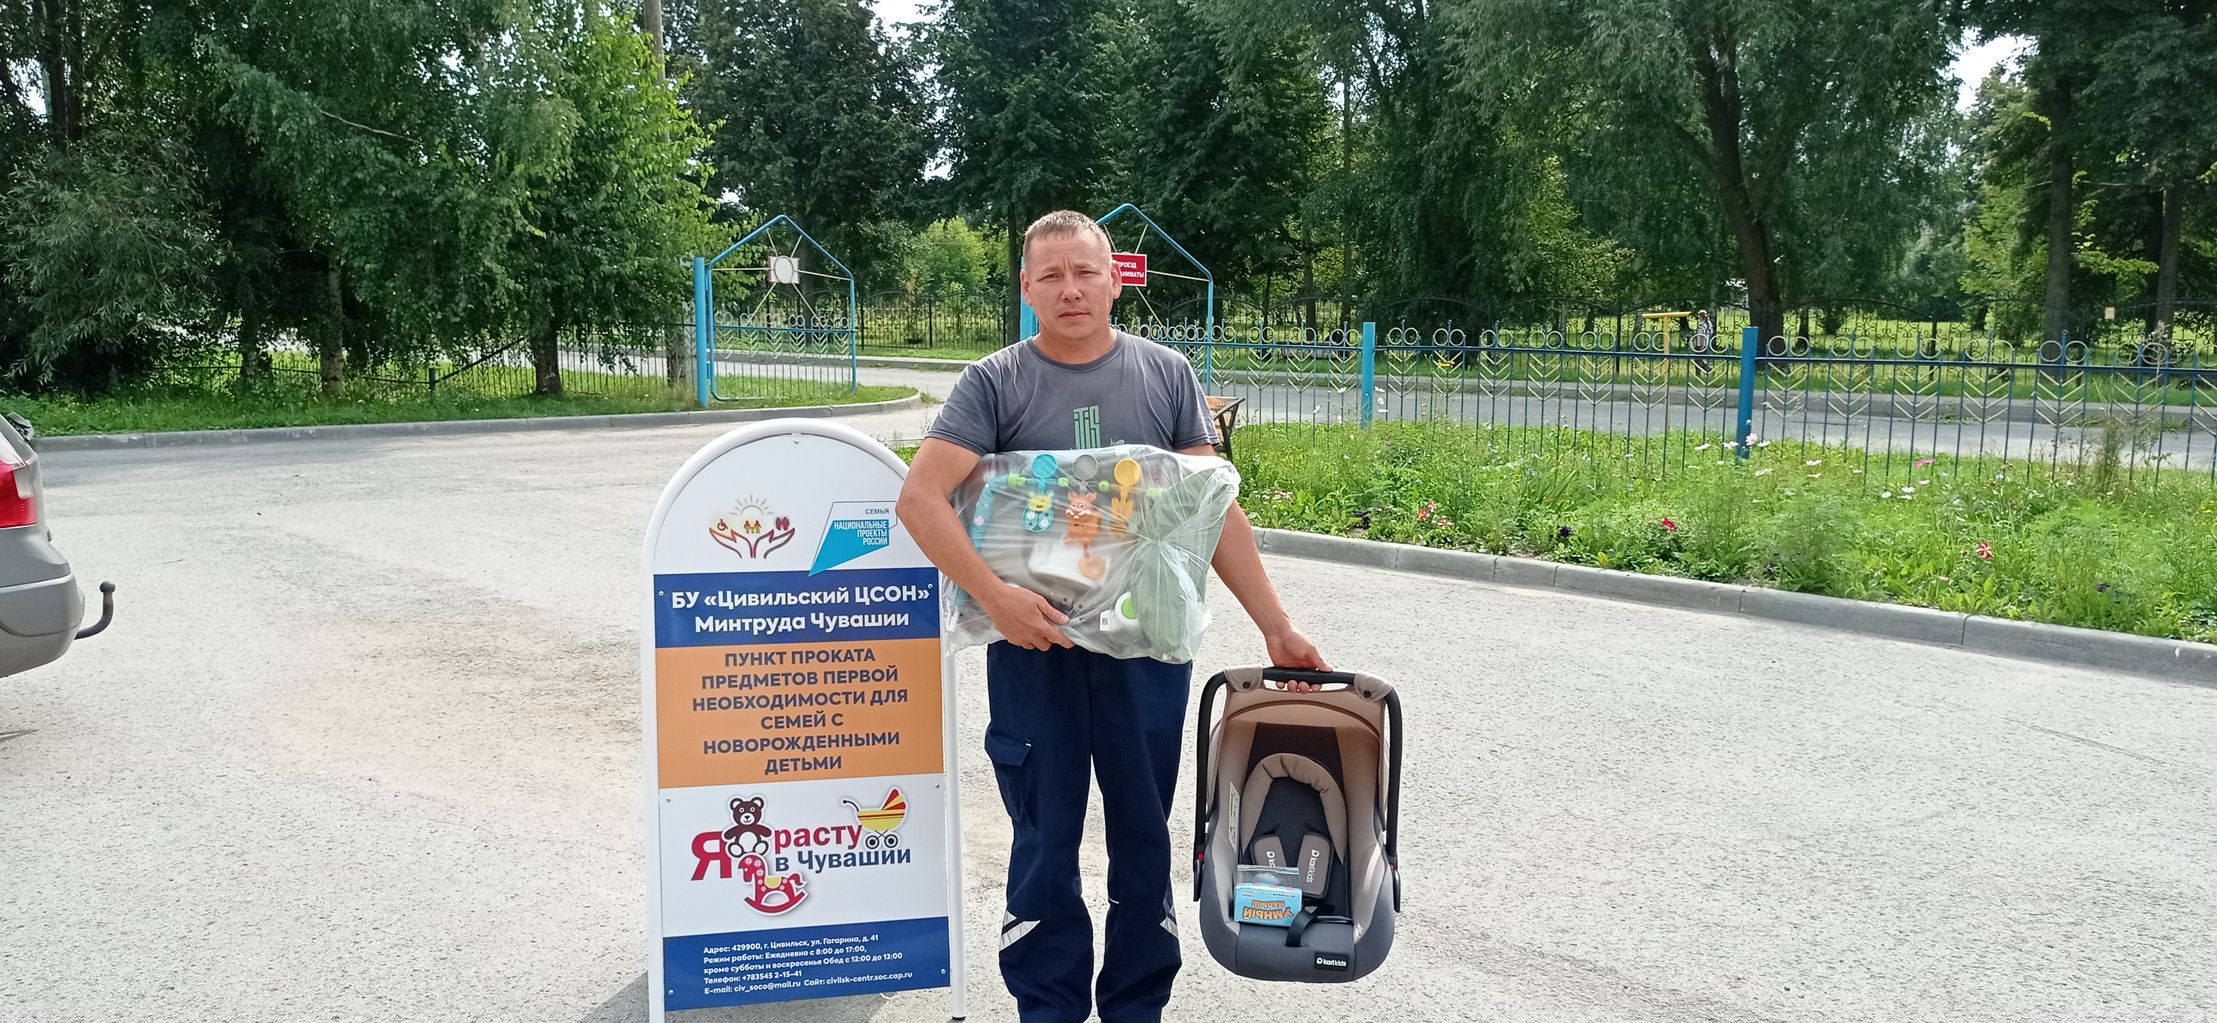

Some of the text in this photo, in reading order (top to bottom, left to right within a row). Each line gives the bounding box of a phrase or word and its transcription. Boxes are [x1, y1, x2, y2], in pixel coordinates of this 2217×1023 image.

[834, 520, 887, 530] НАЦИОНАЛЬНЫЕ
[857, 529, 887, 537] ПРОЕКТЫ
[672, 585, 930, 610] БУ «Цивильский ЦСОН»
[695, 612, 909, 635] Минтруда Чувашии
[725, 648, 876, 667] ПУНКТ ПРОКАТА
[701, 665, 898, 690] ПРЕДМЕТОВ ПЕРВОЙ
[692, 689, 908, 711] НЕОБХОДИМОСТИ ДЛЯ
[760, 711, 844, 730] СЕМЕЙ С
[703, 732, 900, 754] НОВОРОЖДЕННЫМИ
[764, 756, 842, 775] ДЕТЬМИ
[691, 825, 862, 881] Я расту
[775, 849, 911, 874] в Чувашии
[1243, 906, 1293, 920] УМНЫЙ
[703, 946, 731, 954] Адрес:
[732, 943, 763, 951] 429900,
[770, 940, 810, 949] Цивильск,
[823, 937, 861, 945] Гагарина,
[731, 954, 764, 963] работы:
[765, 950, 808, 959] Ежедневно
[834, 947, 844, 955] до
[845, 945, 867, 953] 17:00,
[703, 966, 730, 975] кроме
[730, 963, 764, 973] субботы
[772, 959, 822, 968] воскресенья
[823, 957, 844, 965] Обед
[872, 954, 882, 962] до
[883, 952, 903, 960] 13:00
[703, 970, 802, 984] Телефон: +783545 2-15-41
[704, 986, 733, 994] E-mail:
